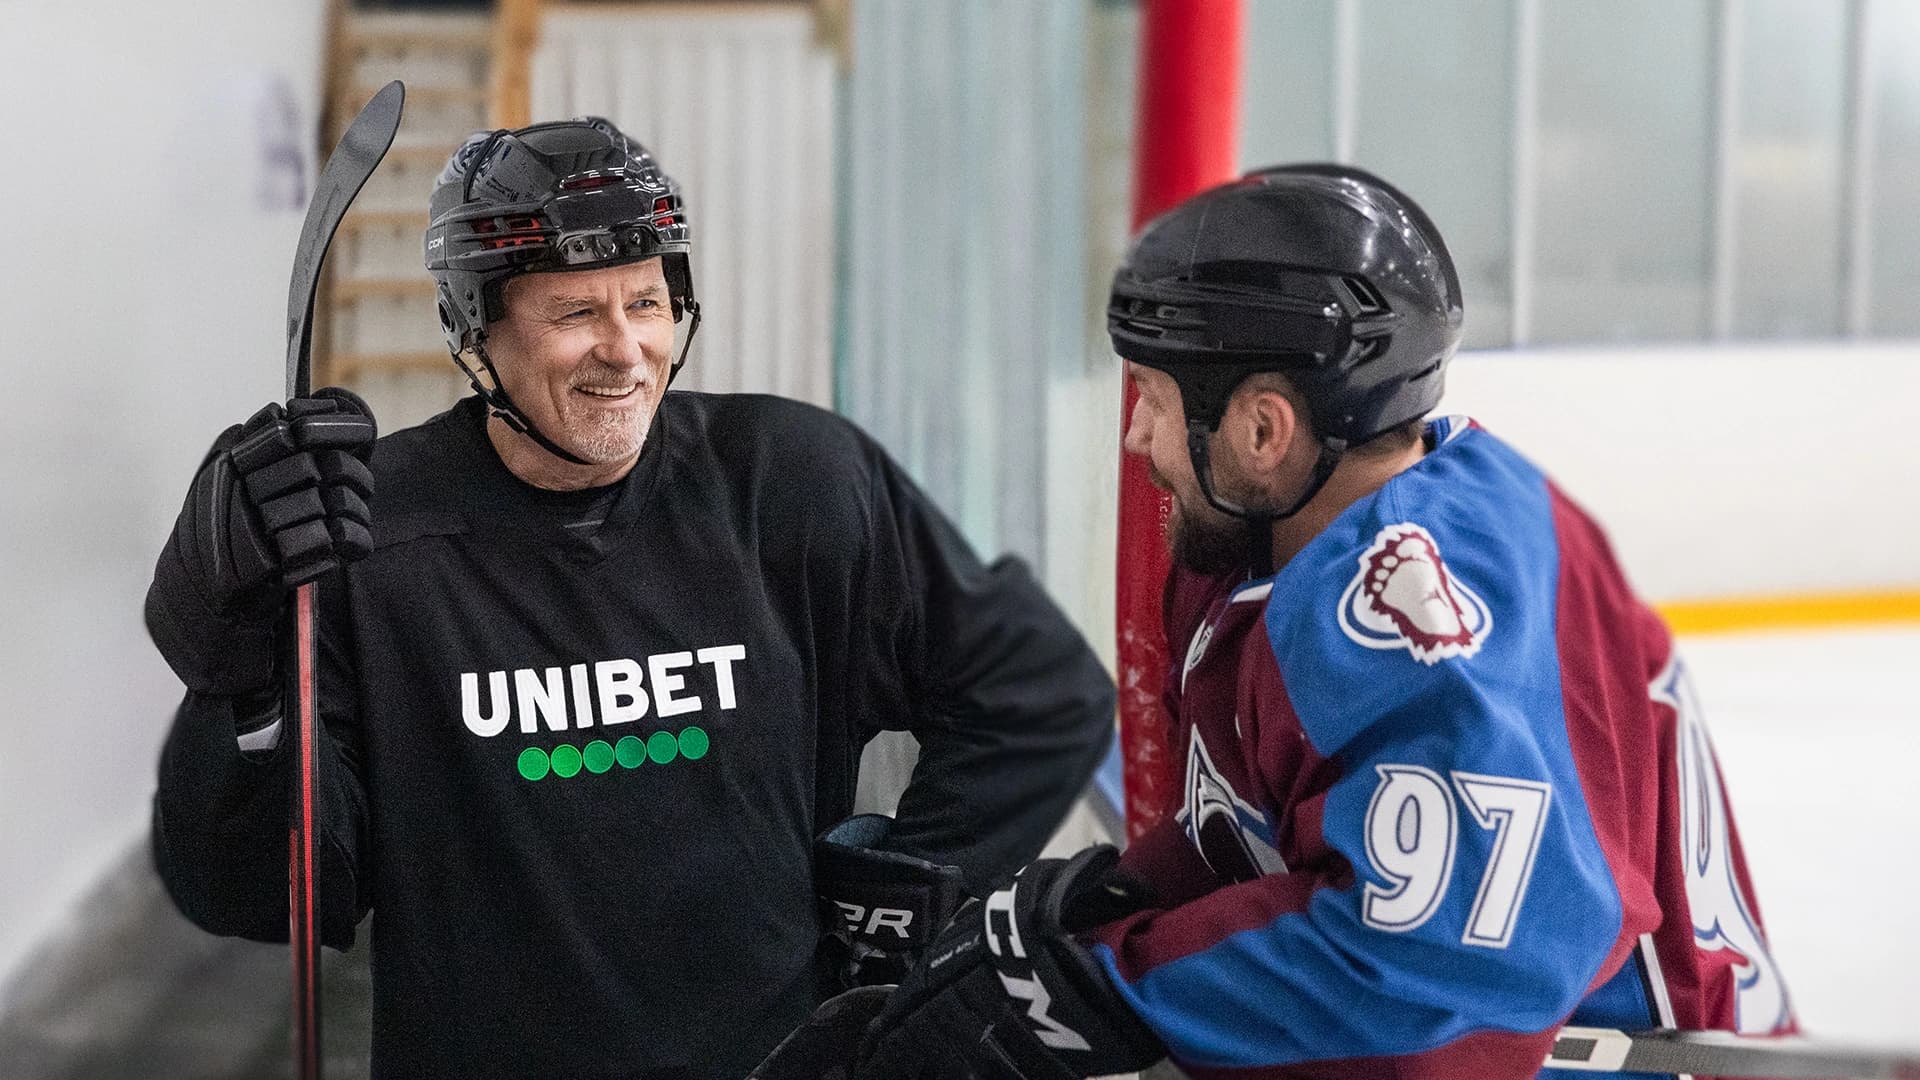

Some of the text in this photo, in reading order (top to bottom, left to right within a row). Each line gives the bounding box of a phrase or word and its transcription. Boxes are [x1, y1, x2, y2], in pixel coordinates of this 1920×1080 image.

[428, 236, 444, 250] CCM
[460, 644, 746, 738] UNIBET
[1362, 763, 1551, 949] 97
